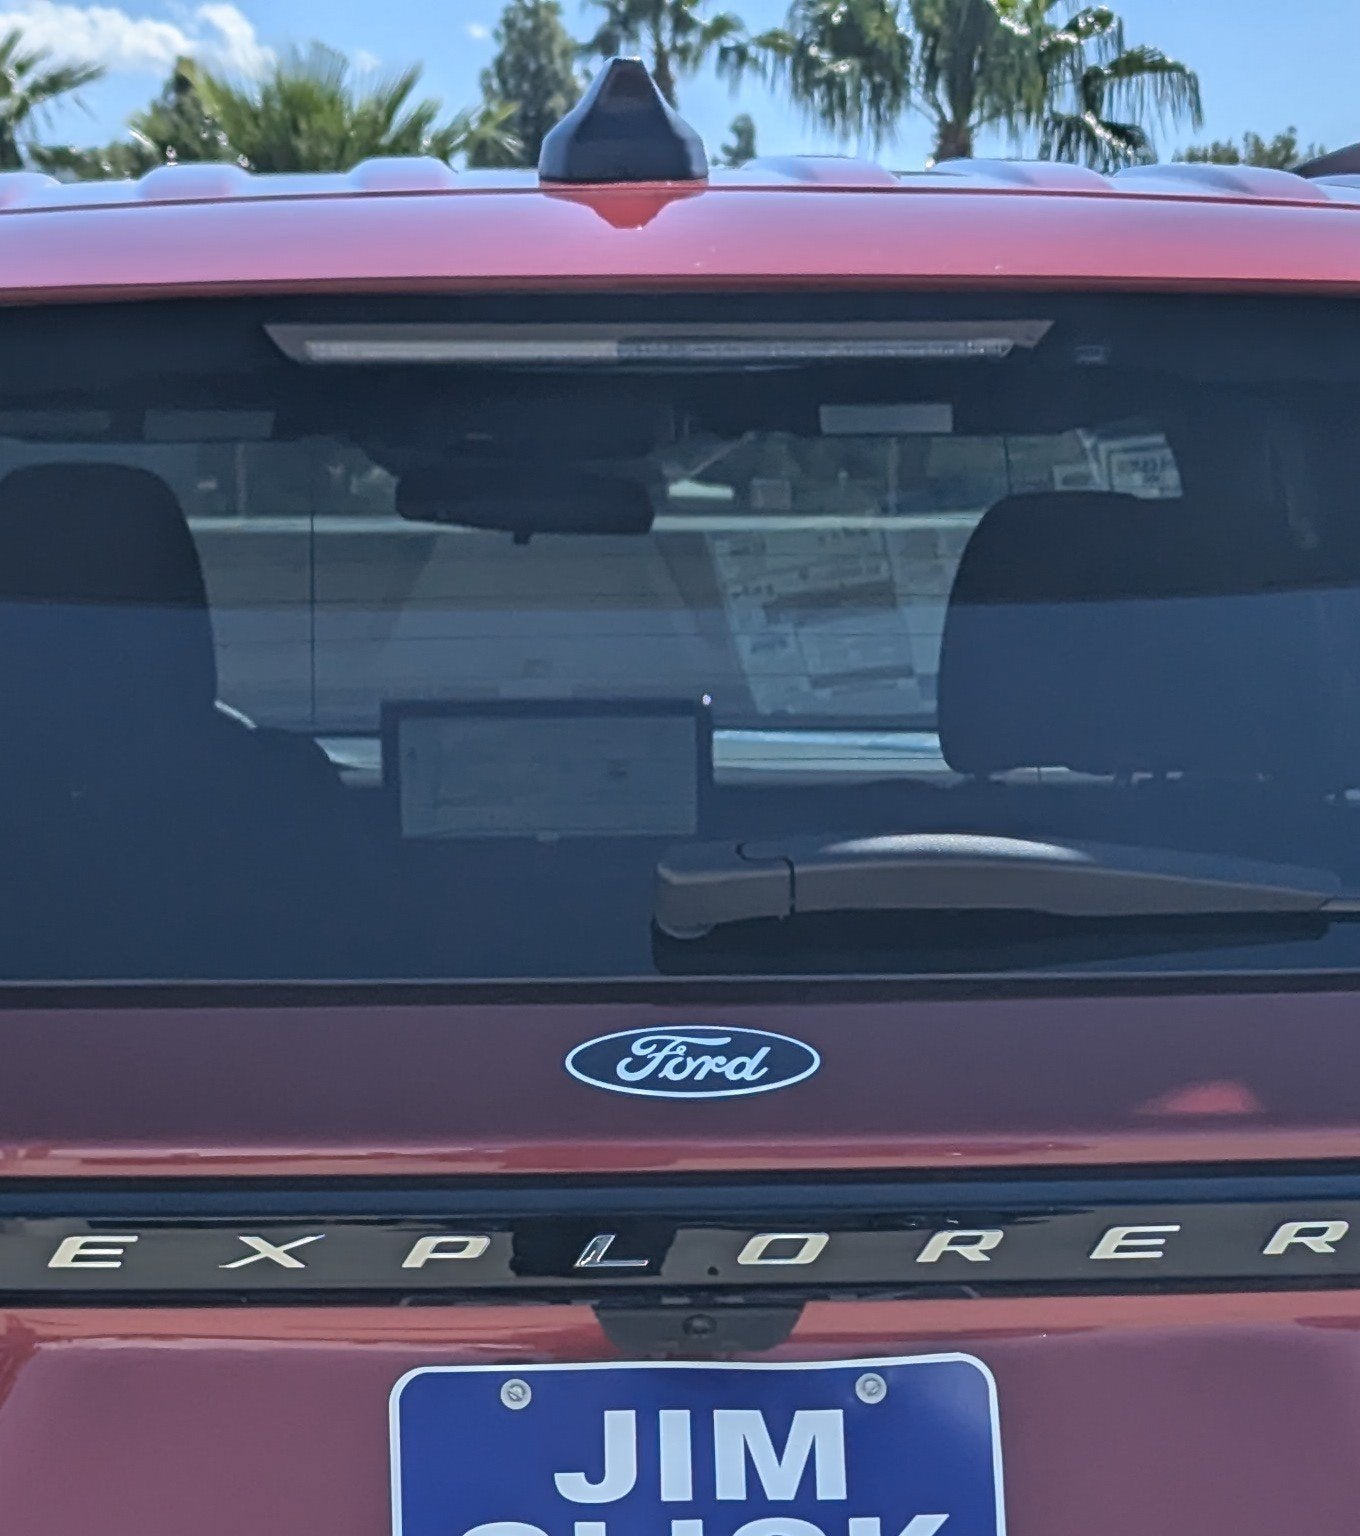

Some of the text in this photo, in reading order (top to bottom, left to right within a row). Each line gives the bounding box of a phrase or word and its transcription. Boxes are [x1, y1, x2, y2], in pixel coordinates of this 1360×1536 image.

[615, 1034, 772, 1083] Ford
[47, 1219, 1350, 1269] EXPLORER
[553, 1408, 848, 1504] JIM
